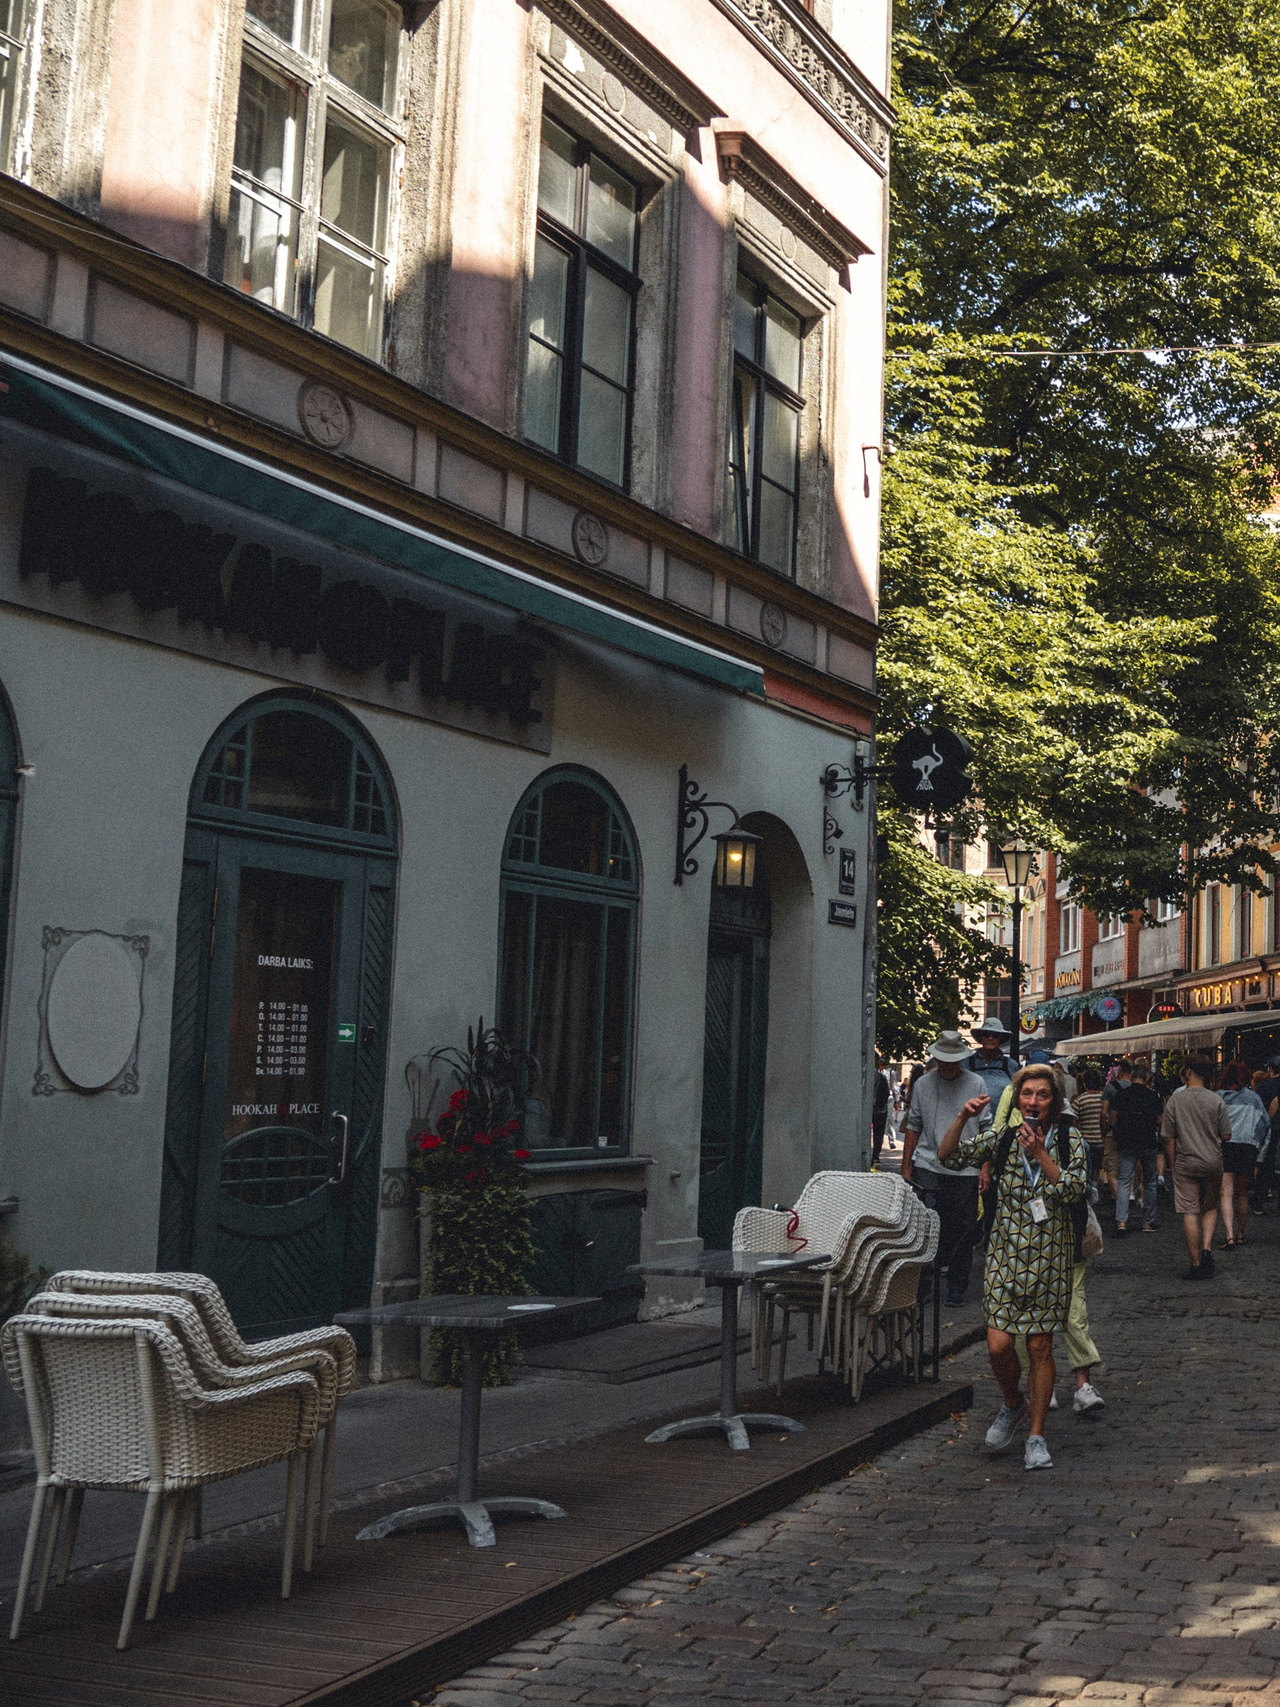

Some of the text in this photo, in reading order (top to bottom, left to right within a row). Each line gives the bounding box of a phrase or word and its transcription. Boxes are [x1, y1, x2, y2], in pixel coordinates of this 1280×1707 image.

[843, 859, 854, 879] 14
[258, 955, 314, 970] DARBA LAIKS:
[1195, 985, 1232, 1008] CUBA
[270, 1002, 286, 1011] 14.00
[269, 1012, 286, 1021] 14.00
[268, 1023, 285, 1032] 14.00
[268, 1034, 284, 1043] 14.00
[267, 1045, 284, 1054] 14.00
[267, 1056, 283, 1065] 14.00
[266, 1067, 283, 1075] 14.00
[232, 1103, 320, 1116] HOOKAH PLACE
